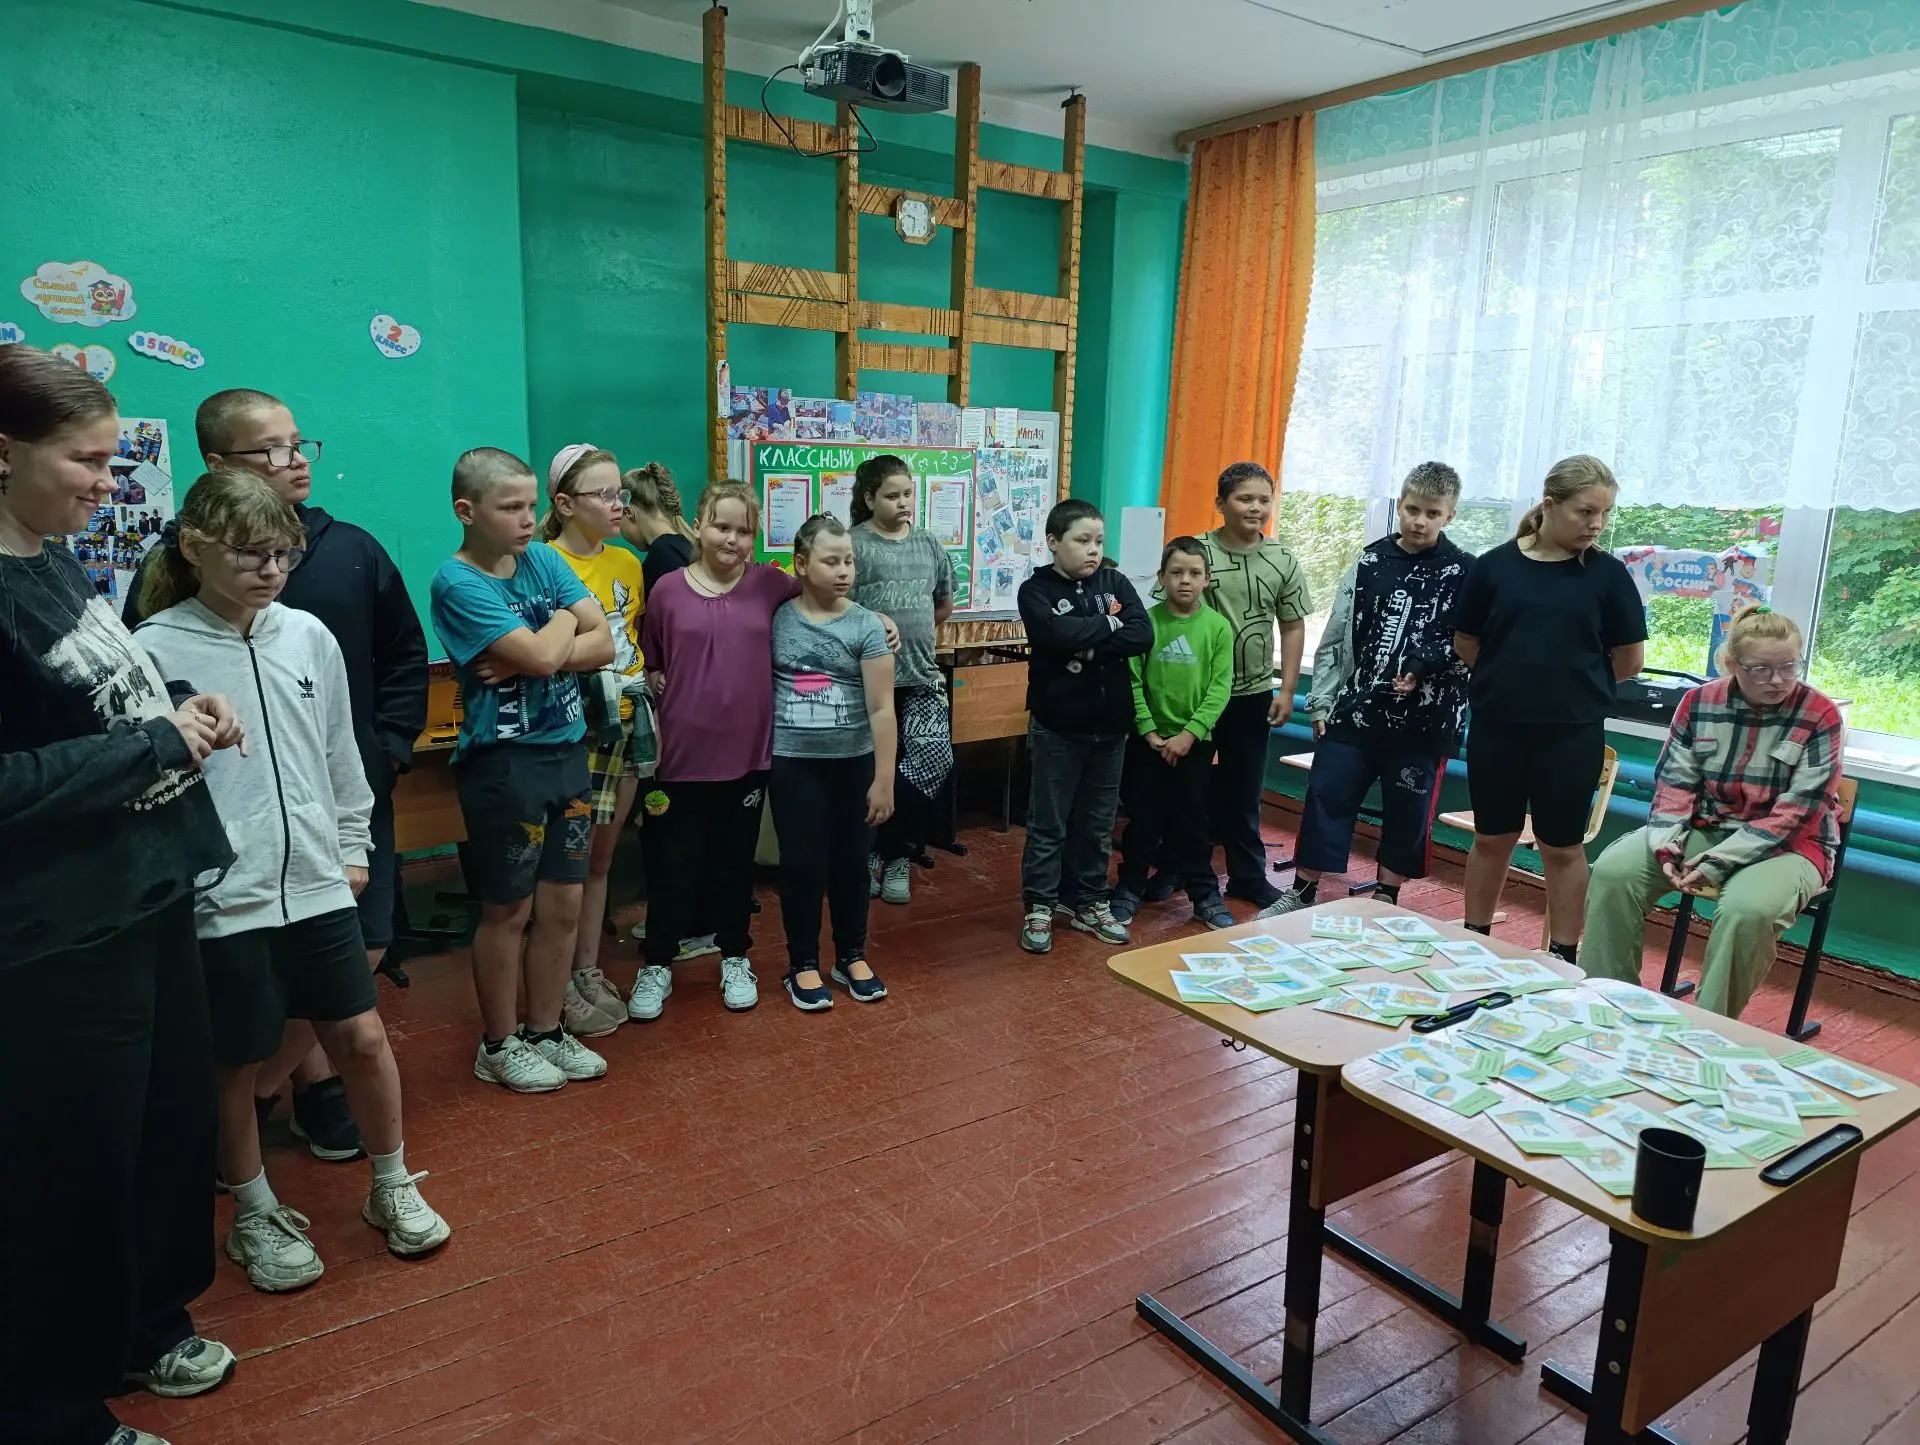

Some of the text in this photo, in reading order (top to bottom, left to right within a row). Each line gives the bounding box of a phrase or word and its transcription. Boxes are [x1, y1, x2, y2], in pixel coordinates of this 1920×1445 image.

[147, 337, 157, 350] 5
[388, 325, 402, 342] 2
[759, 446, 855, 469] КЛАССНЫЙ
[1665, 562, 1703, 575] ДЕНЬ
[1390, 589, 1408, 613] OFF
[1377, 615, 1401, 655] WHITE
